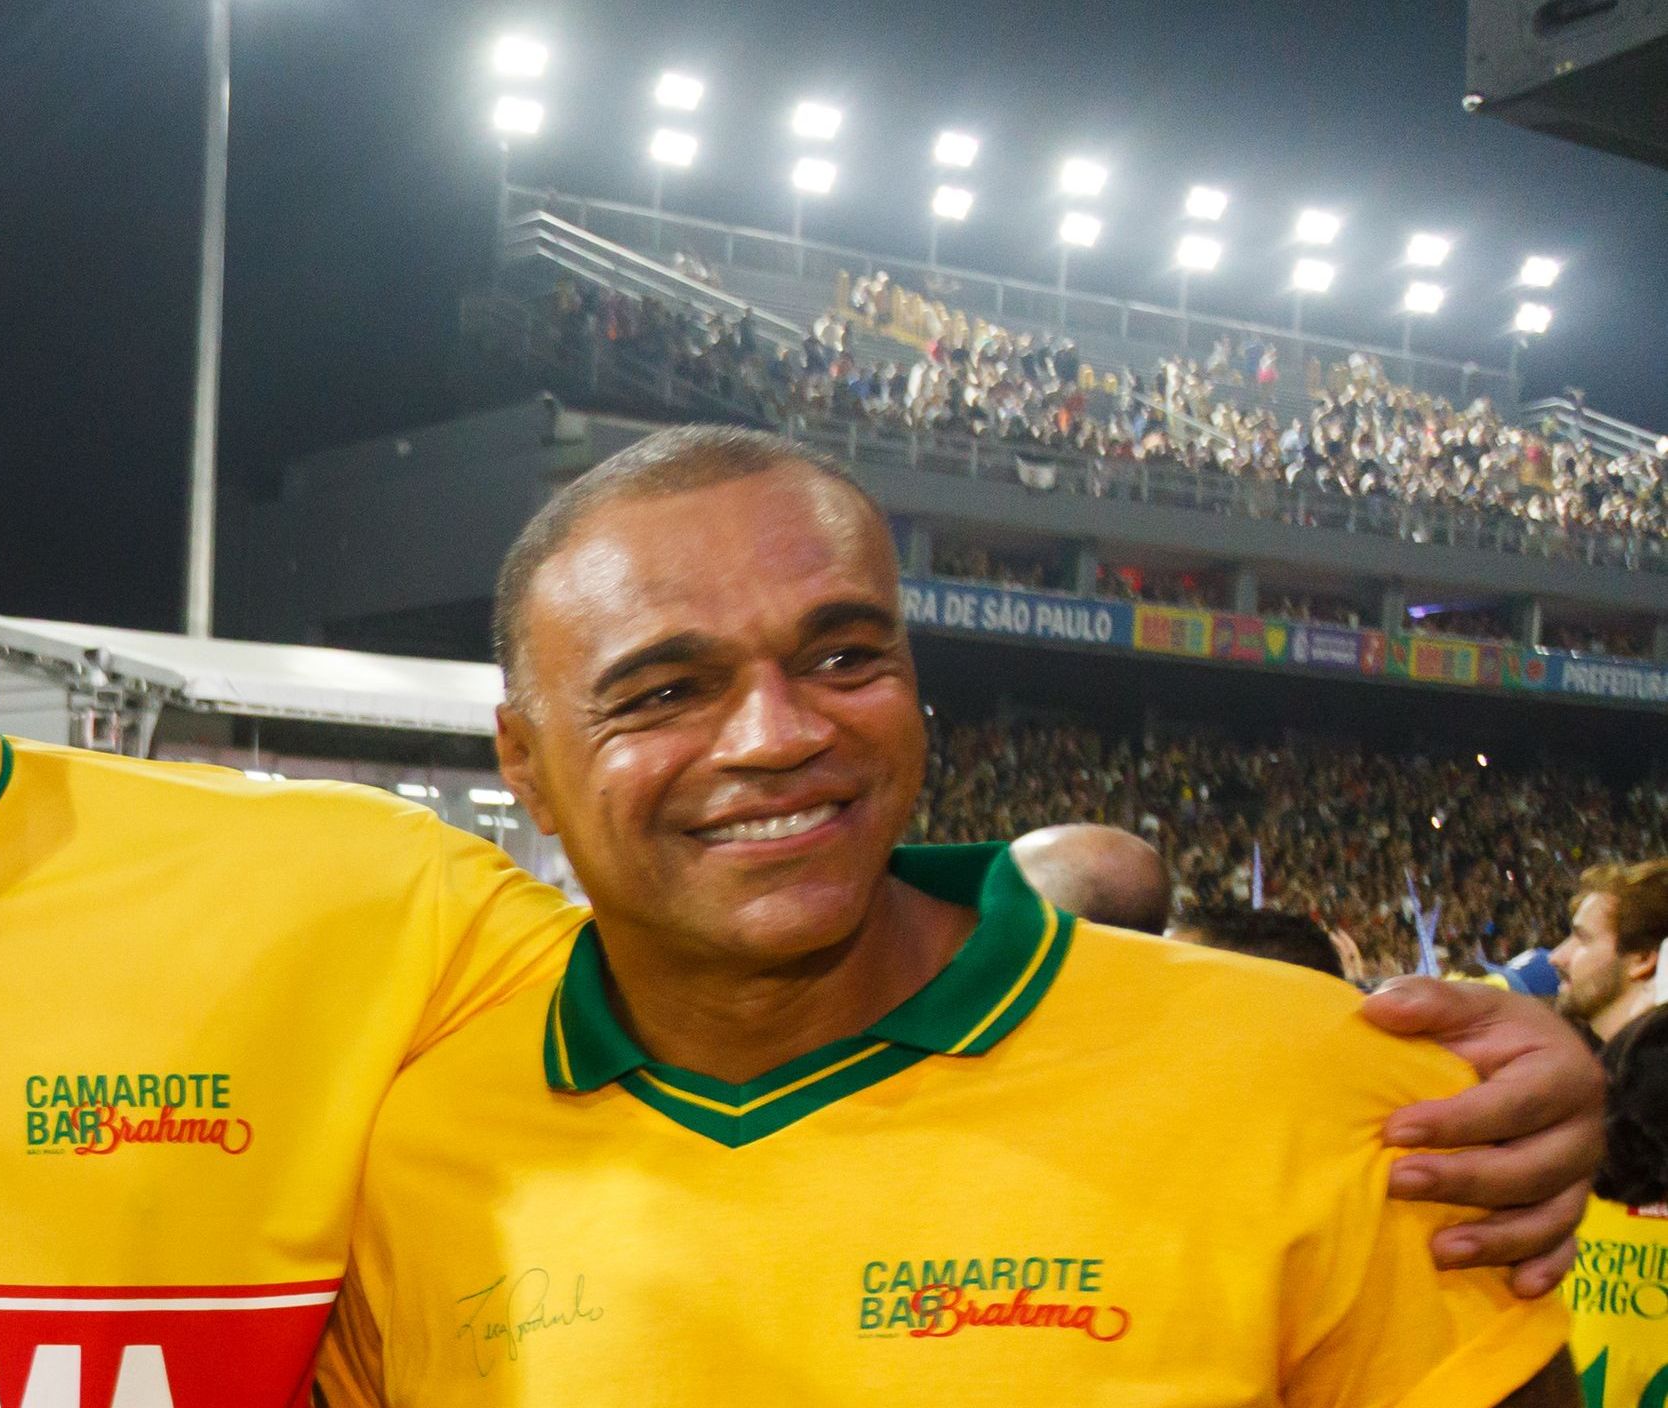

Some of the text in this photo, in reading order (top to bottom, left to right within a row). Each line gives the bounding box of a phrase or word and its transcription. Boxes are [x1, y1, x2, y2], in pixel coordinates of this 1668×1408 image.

[944, 592, 976, 629] DE
[981, 594, 1030, 635] SÃO
[1035, 603, 1113, 643] PAULO
[25, 1073, 231, 1109] CAMAROTE
[26, 1100, 253, 1155] BAR Brahma
[862, 1256, 1105, 1294] CAMAROTE
[859, 1283, 1132, 1341] BAR Brahma
